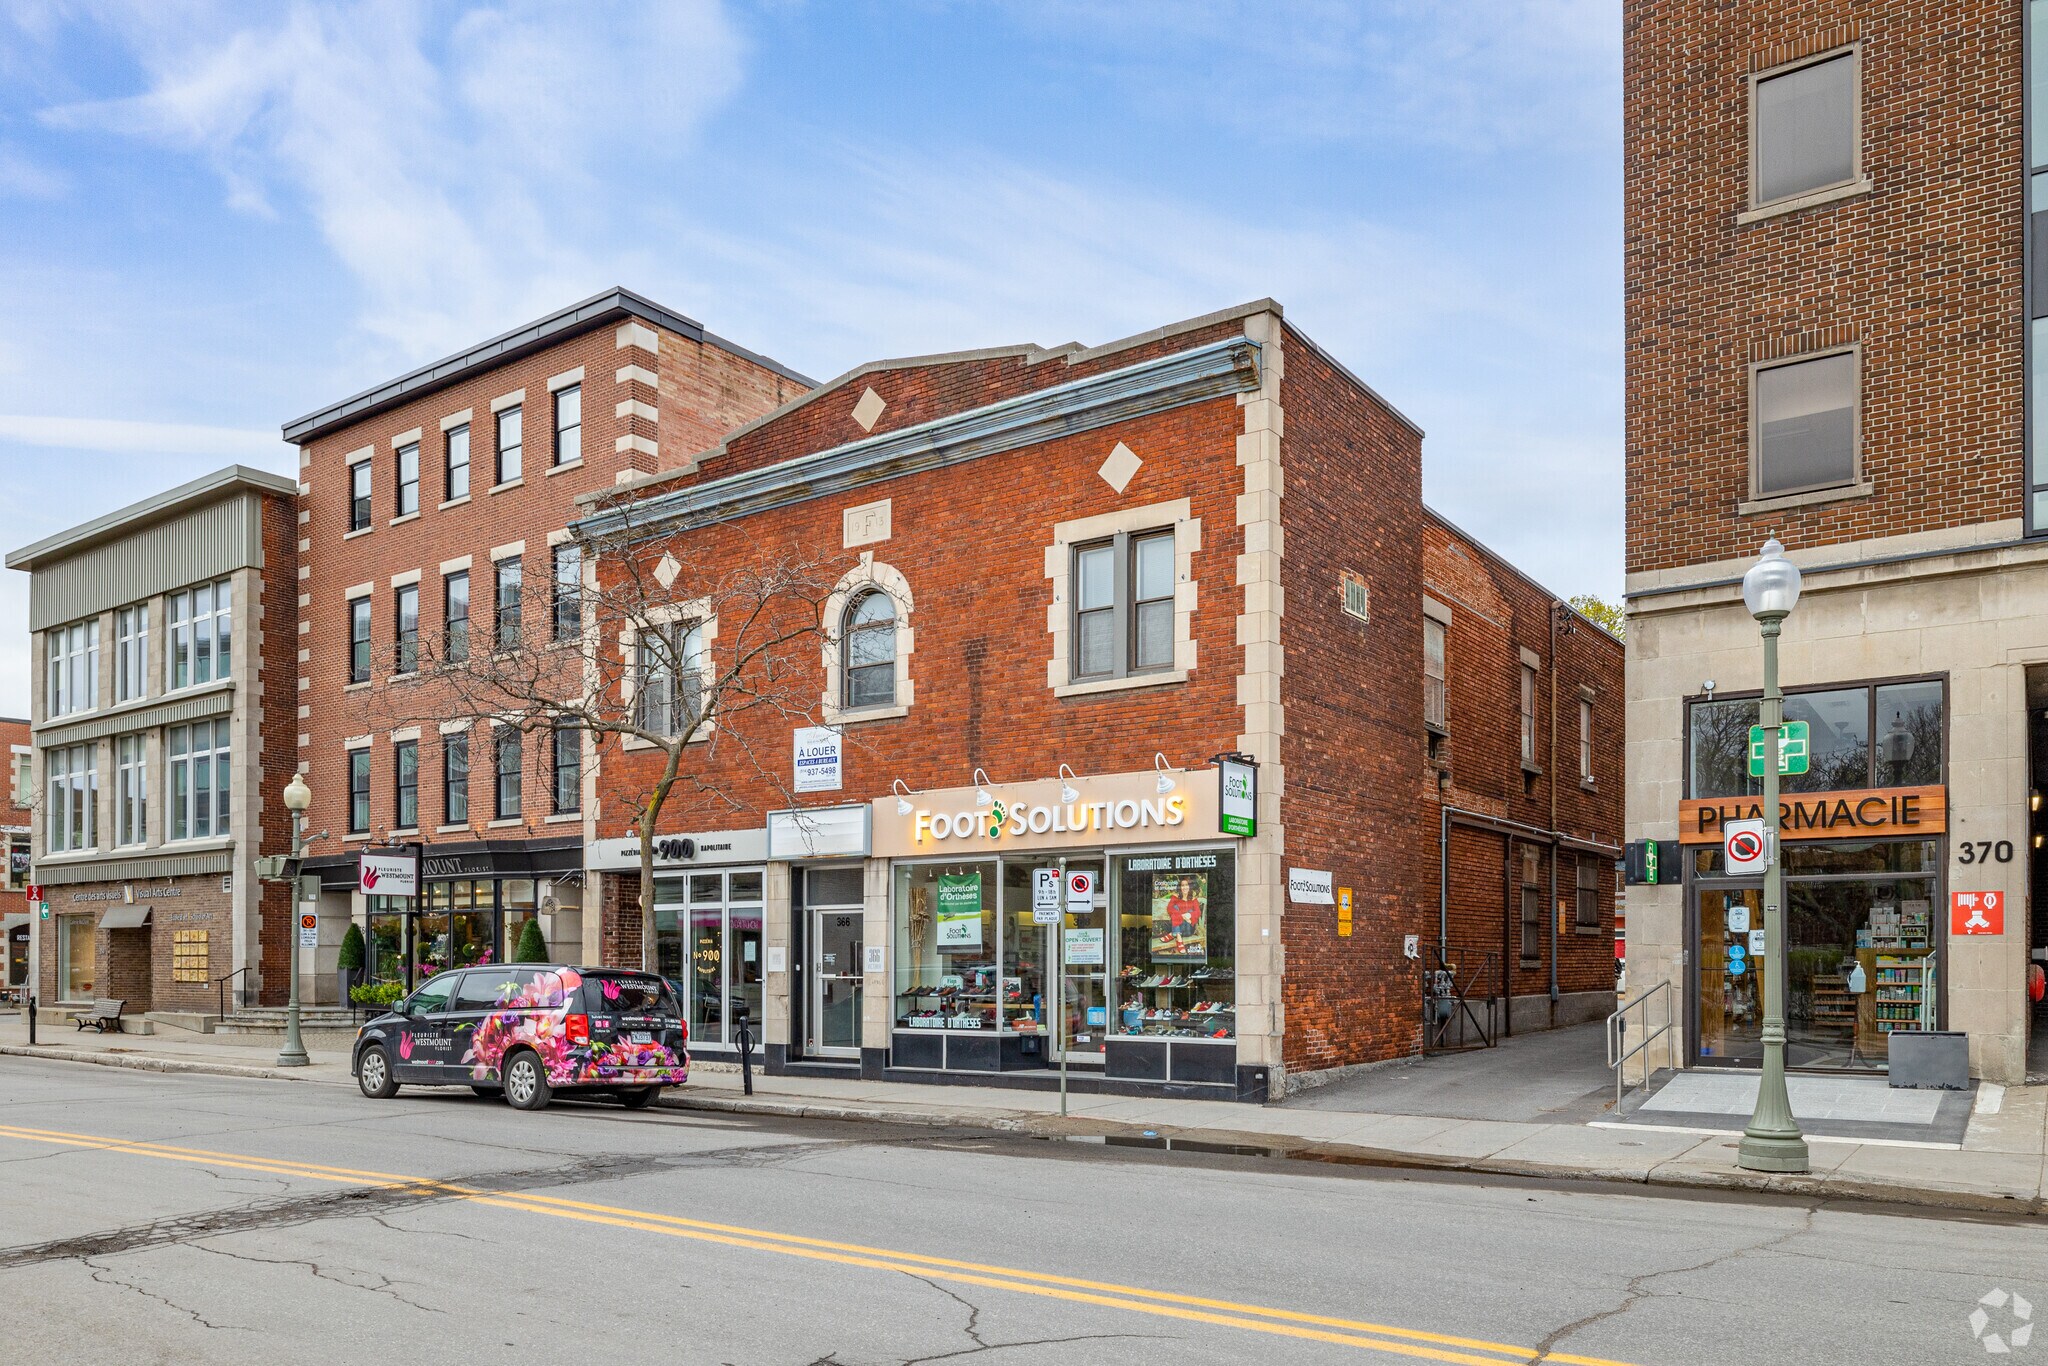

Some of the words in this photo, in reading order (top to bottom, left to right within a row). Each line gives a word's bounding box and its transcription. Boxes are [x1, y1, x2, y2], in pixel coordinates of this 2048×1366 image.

[807, 745, 836, 757] LOUER
[807, 766, 836, 776] 937-5498
[1229, 775, 1242, 789] FOOT
[915, 810, 989, 842] FOOT
[1009, 796, 1184, 836] SOLUTIONS
[659, 838, 695, 860] 900
[1957, 840, 2014, 865] 370
[1128, 857, 1172, 871] LABORATOIRE
[136, 887, 152, 899] Visual
[153, 888, 163, 897] Arts
[164, 887, 181, 897] Centre
[939, 884, 979, 893] Laboratoire
[1290, 880, 1304, 892] FOOT
[1305, 881, 1331, 894] SOLUTIONS
[73, 893, 88, 902] Centre
[88, 892, 98, 900] des
[940, 893, 978, 901] d'Orthèses
[836, 917, 850, 927] 366
[702, 950, 720, 961] 900
[868, 949, 881, 962] 366
[620, 983, 657, 991] WESTMOUNT
[908, 1016, 945, 1028] LABORATOIRE
[414, 1038, 452, 1046] WESTMOUNT
